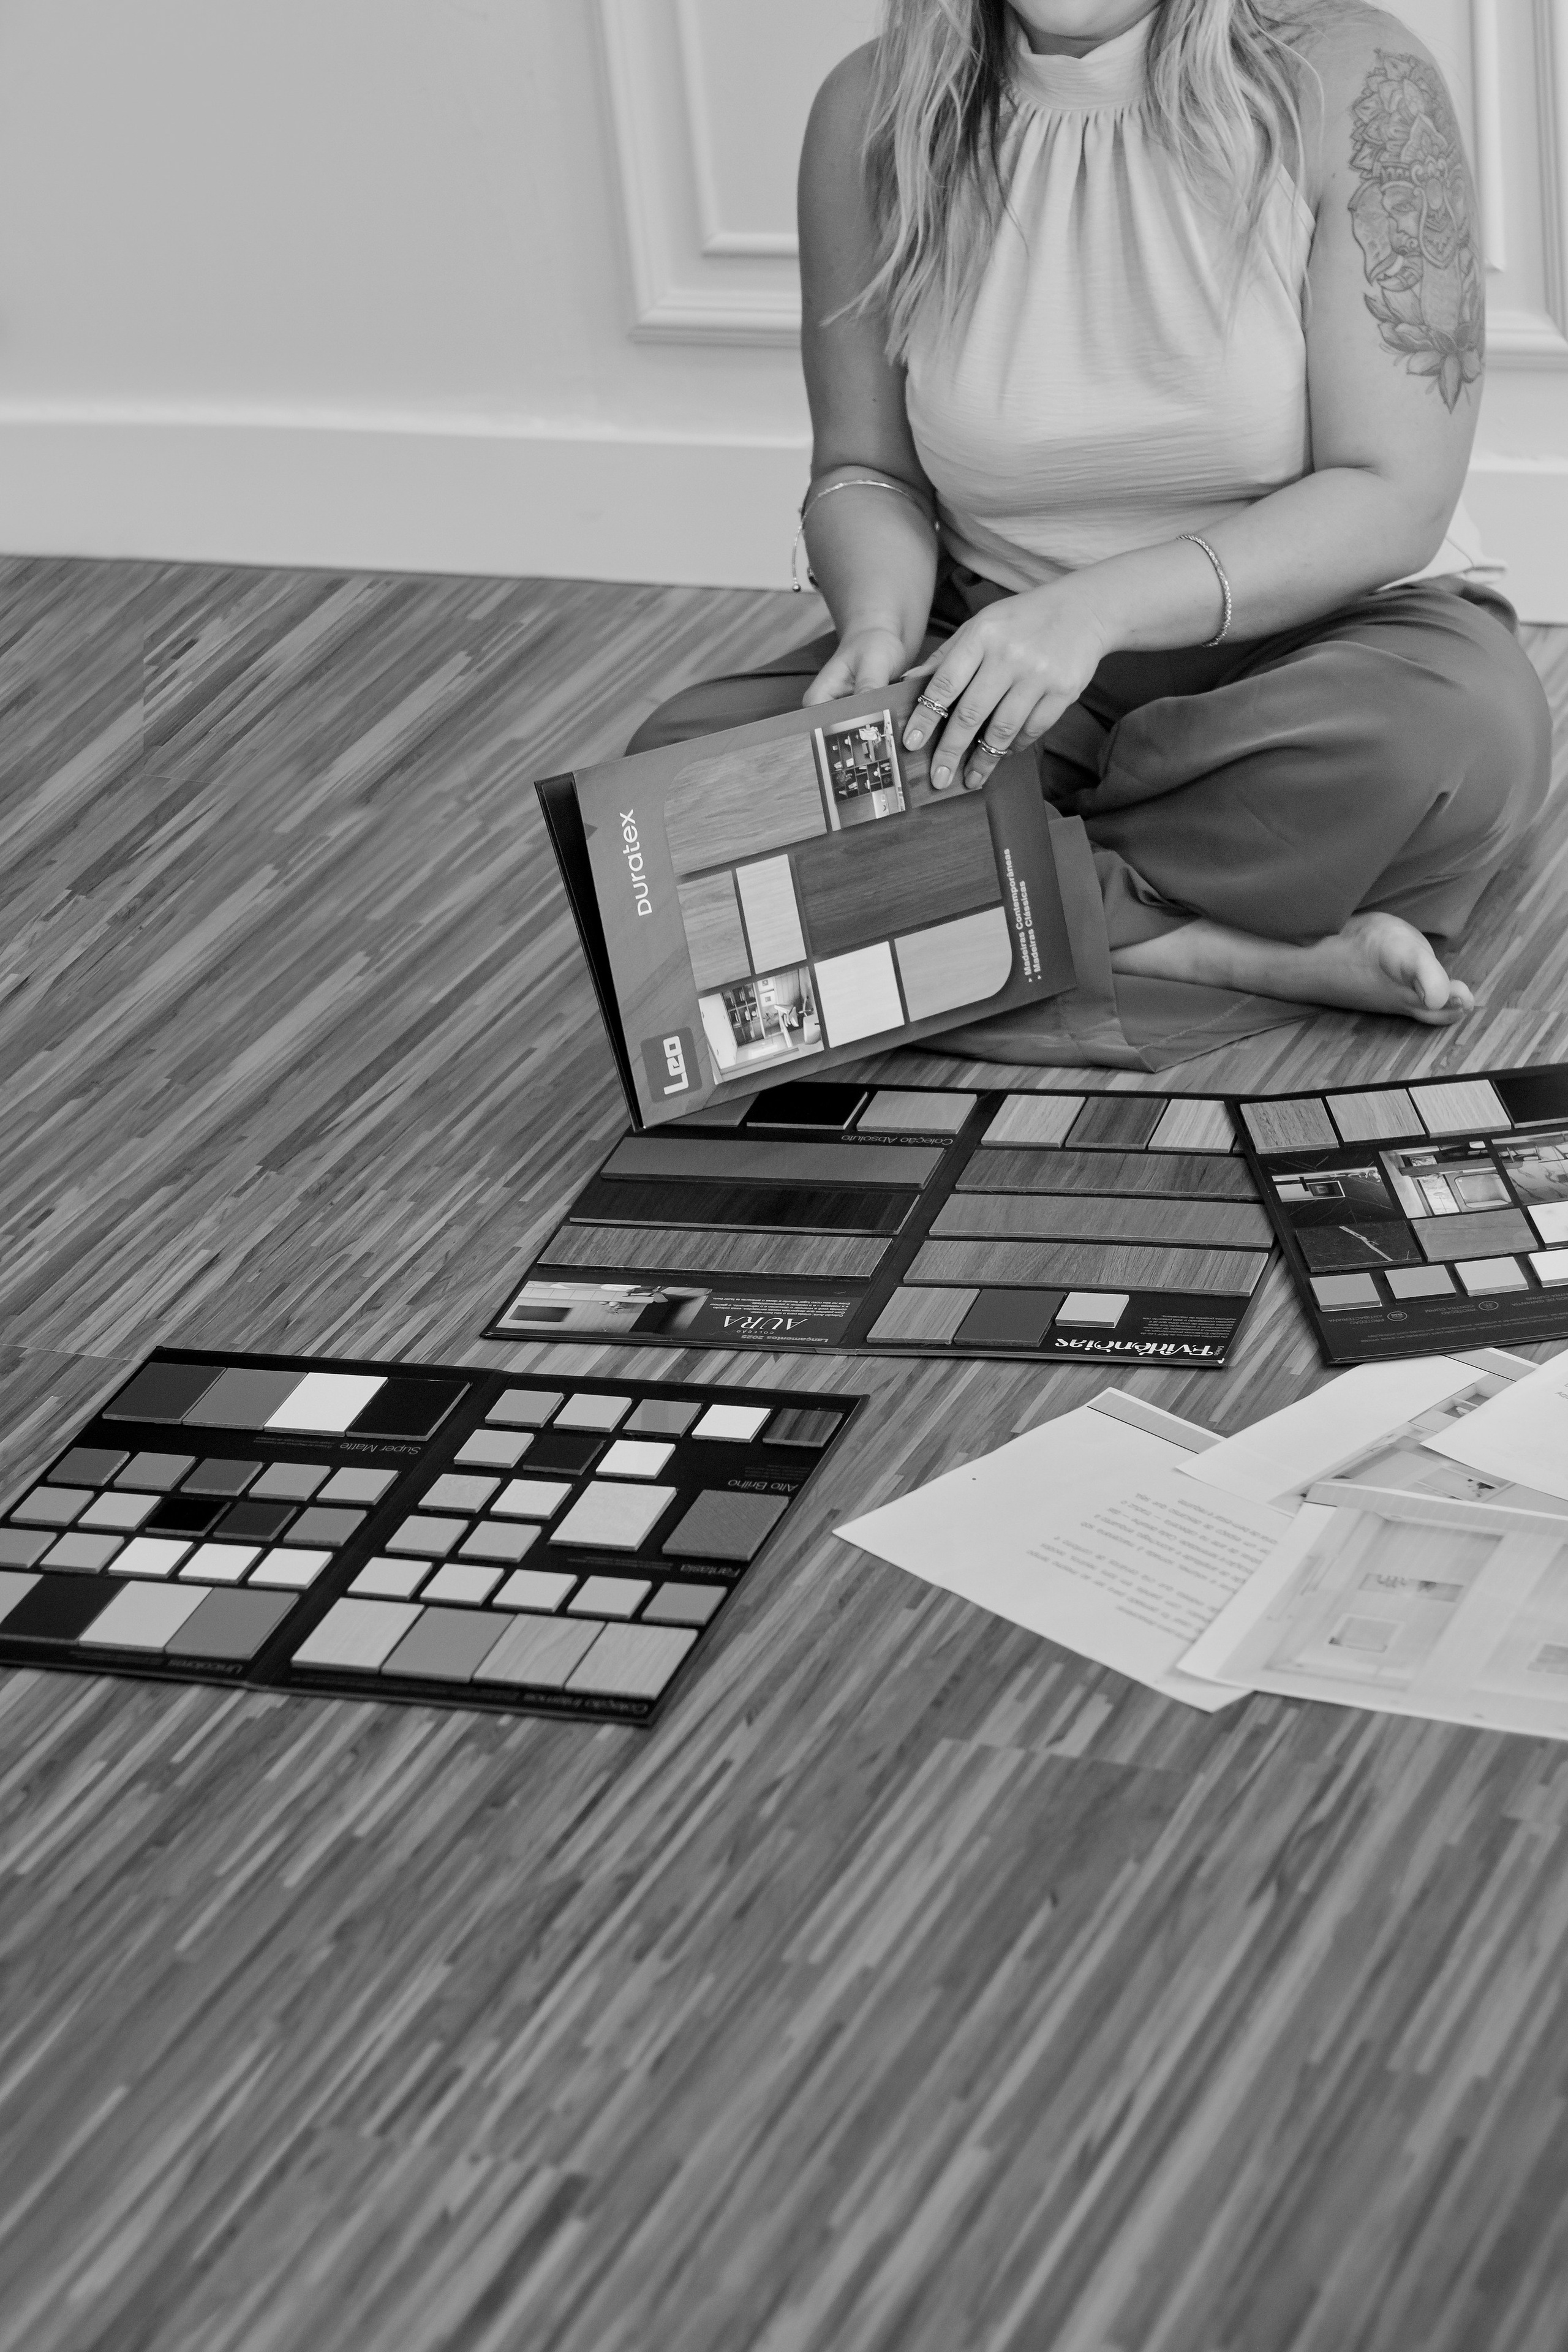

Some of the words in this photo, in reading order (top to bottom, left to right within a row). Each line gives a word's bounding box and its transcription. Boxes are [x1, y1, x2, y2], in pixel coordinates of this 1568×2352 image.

[619, 809, 653, 917] Duratex
[1003, 848, 1023, 930] Contemporâneas
[1019, 880, 1033, 927] Clássicas
[1019, 931, 1032, 976] Madeiras
[1028, 929, 1041, 973] Madeiras
[841, 1135, 898, 1144] Absoluto
[900, 1137, 954, 1145] Coleção
[723, 1315, 809, 1330] AURA
[1055, 1338, 1214, 1356] Evidências
[340, 1442, 378, 1452] Matte
[379, 1445, 421, 1455] Super
[728, 1479, 768, 1490] Brilho
[771, 1482, 799, 1492] Alto
